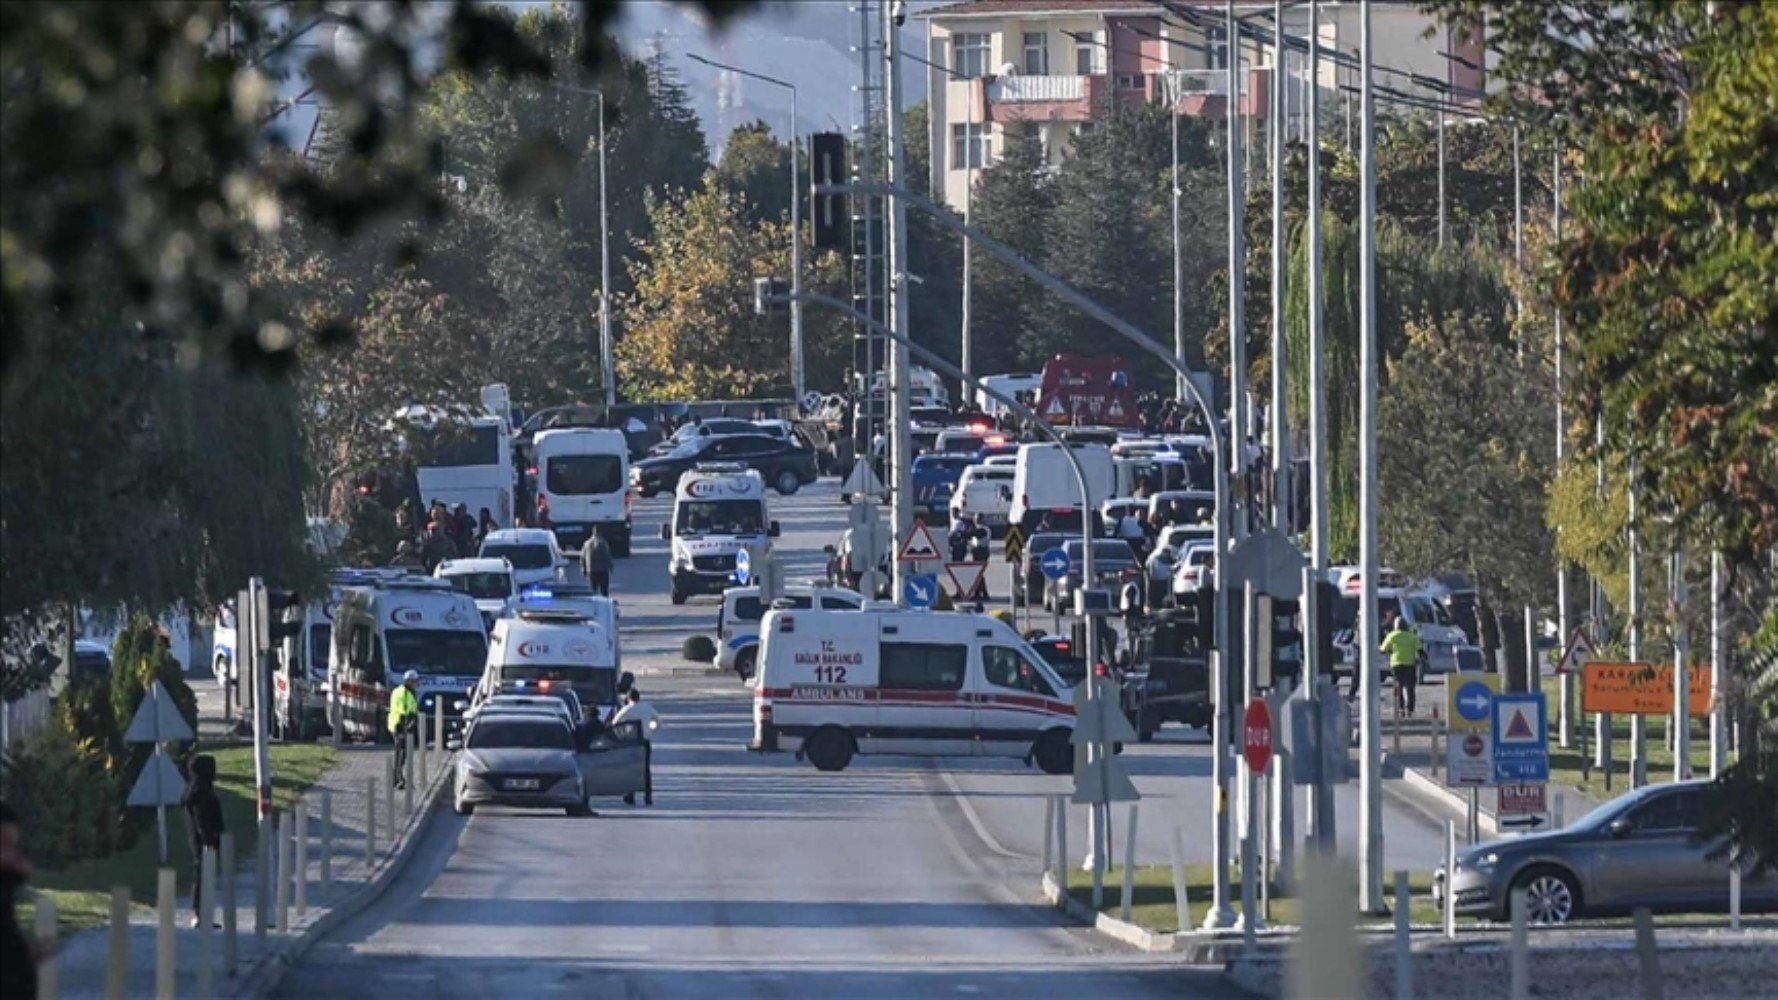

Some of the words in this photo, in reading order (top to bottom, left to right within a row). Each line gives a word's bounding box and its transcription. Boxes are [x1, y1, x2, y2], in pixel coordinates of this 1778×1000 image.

[814, 666, 847, 683] 112
[792, 688, 865, 700] AMBULANS
[1246, 726, 1269, 746] DUR
[1503, 785, 1540, 797] DUR
